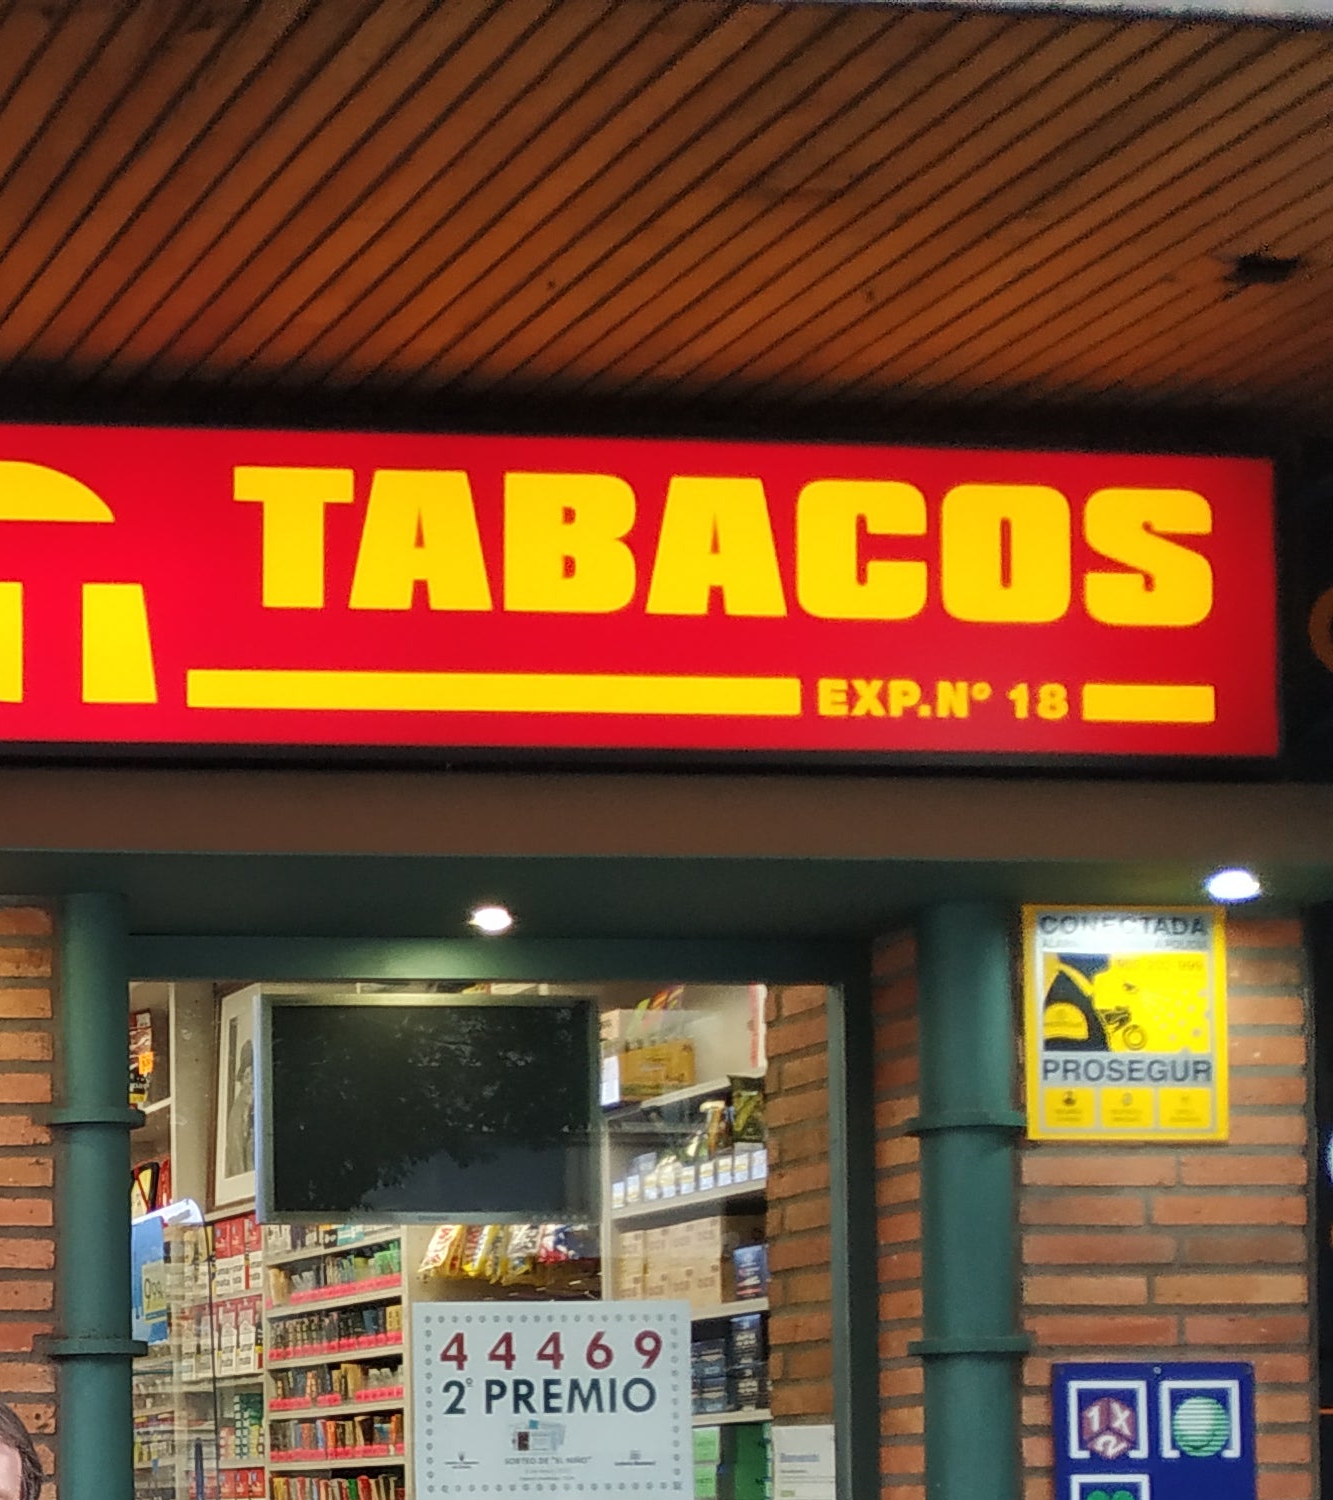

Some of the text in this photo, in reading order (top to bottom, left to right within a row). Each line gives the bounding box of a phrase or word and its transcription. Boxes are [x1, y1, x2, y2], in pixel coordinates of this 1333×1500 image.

[233, 465, 1214, 627] TABACOS
[1009, 682, 1070, 720] 18
[1039, 914, 1208, 936] CONECTADA
[1041, 1058, 1213, 1082] PROSEGUR
[439, 1329, 663, 1371] 44469
[485, 1377, 657, 1415] PREMIO
